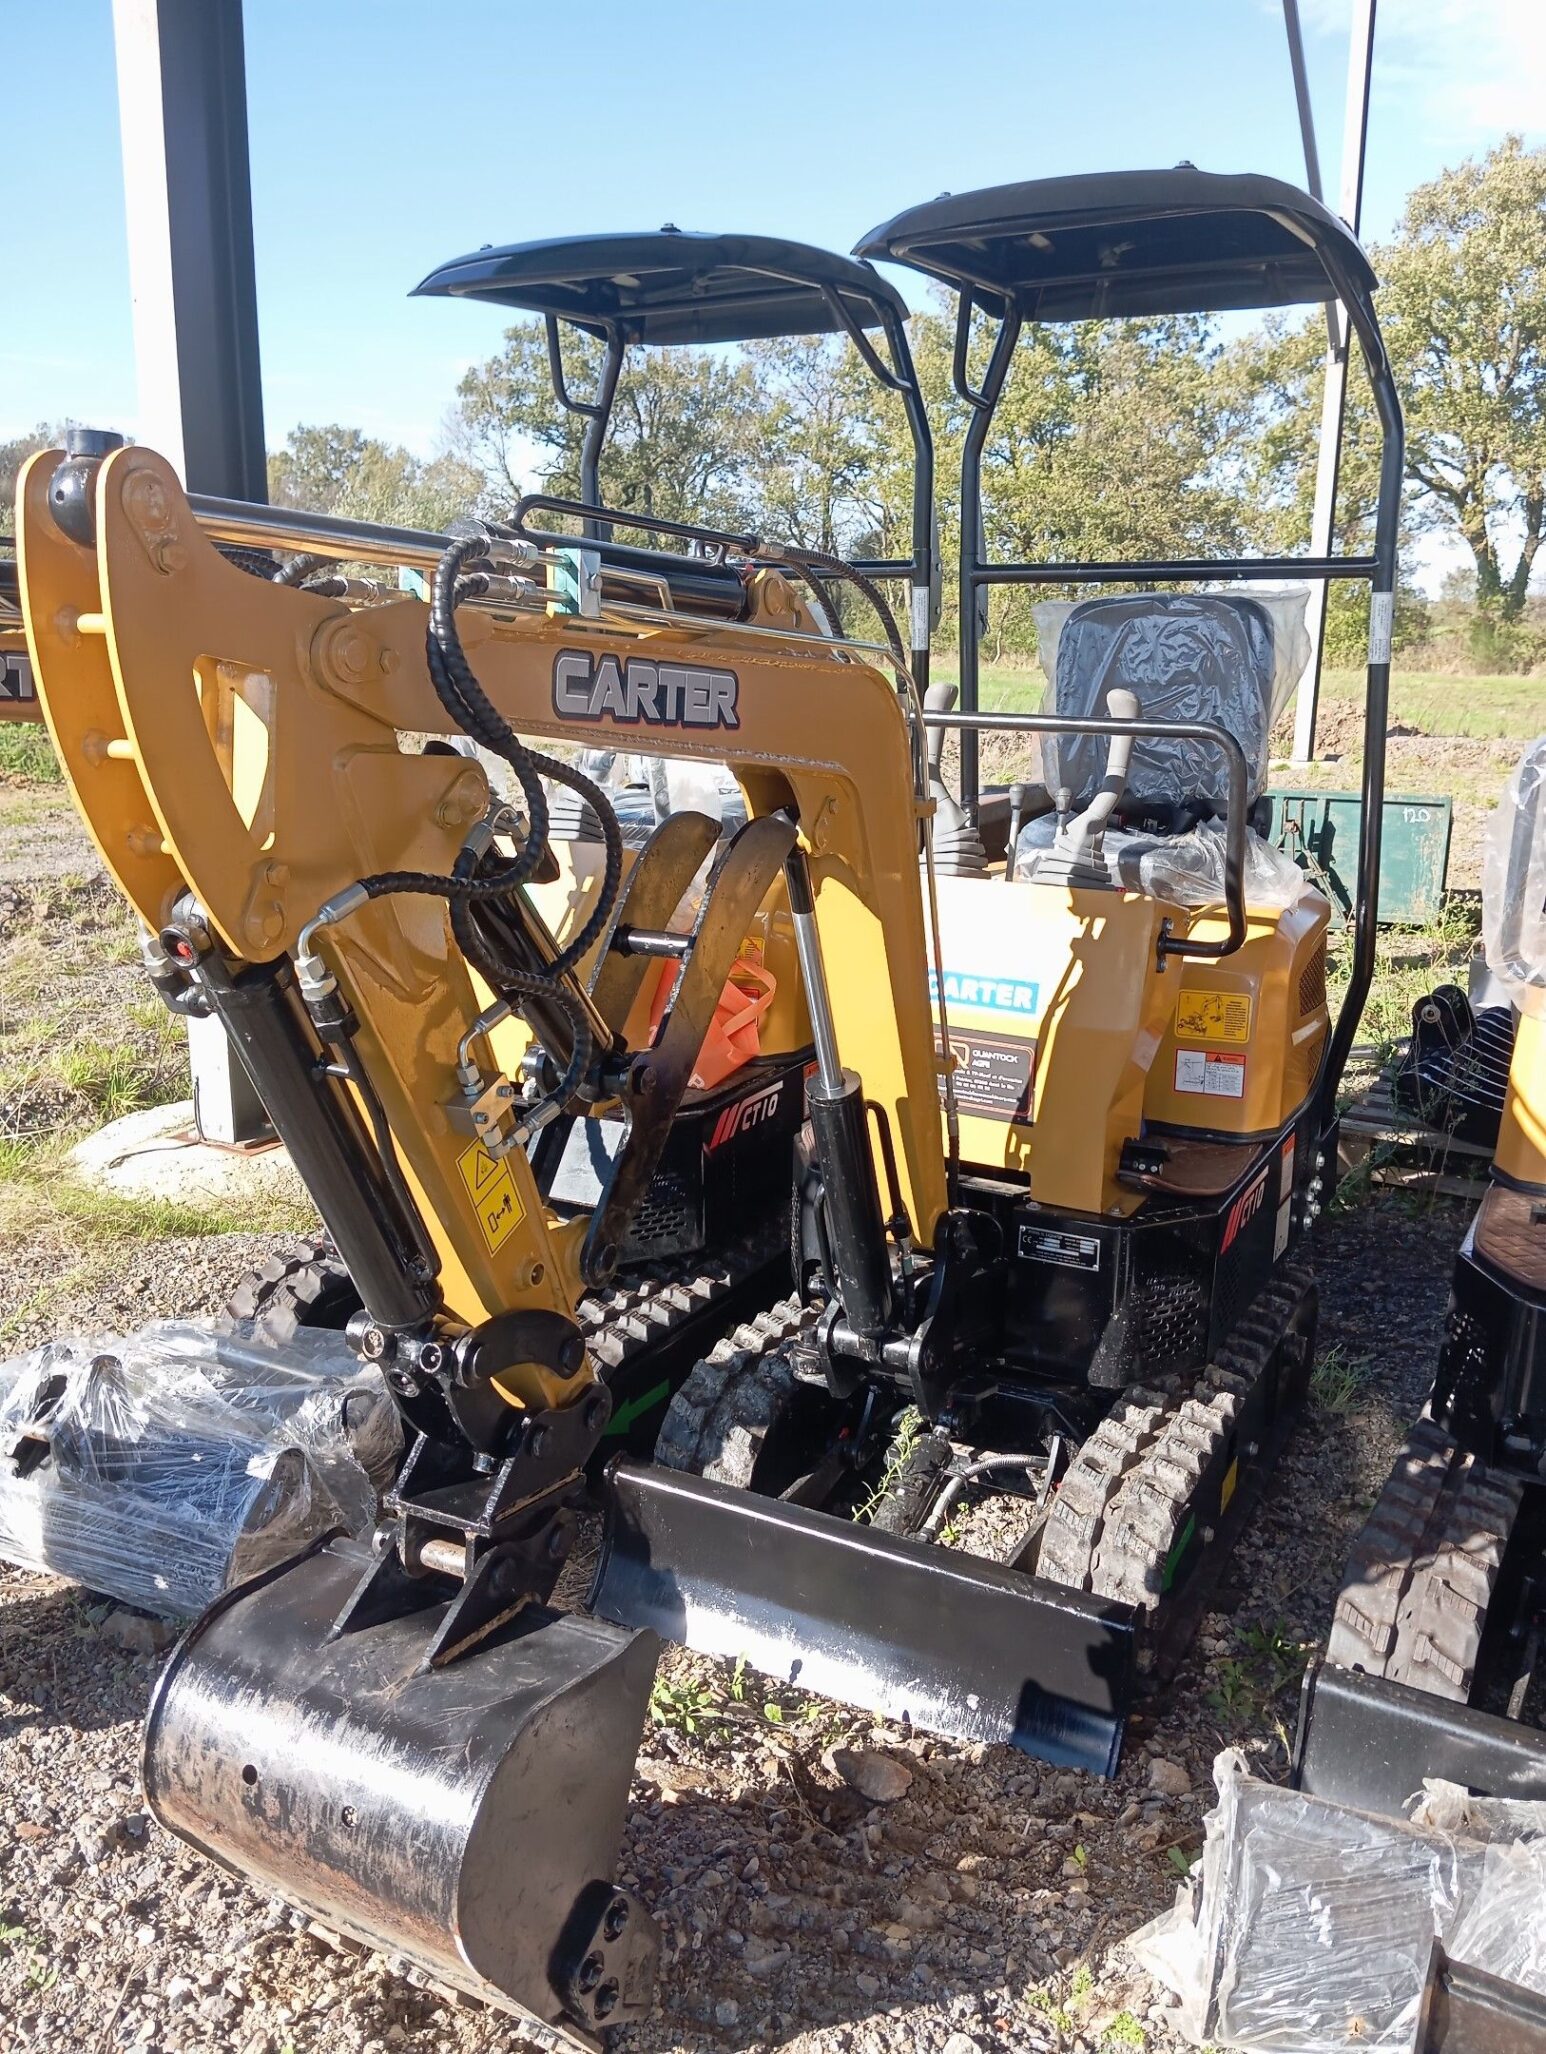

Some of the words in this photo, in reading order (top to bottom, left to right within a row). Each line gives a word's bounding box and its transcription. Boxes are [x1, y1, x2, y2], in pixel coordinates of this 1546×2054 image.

[553, 650, 740, 728] CARTER
[1403, 807, 1431, 823] 120
[928, 973, 1033, 1010] CARTER
[972, 1050, 1018, 1064] QUANTOCK
